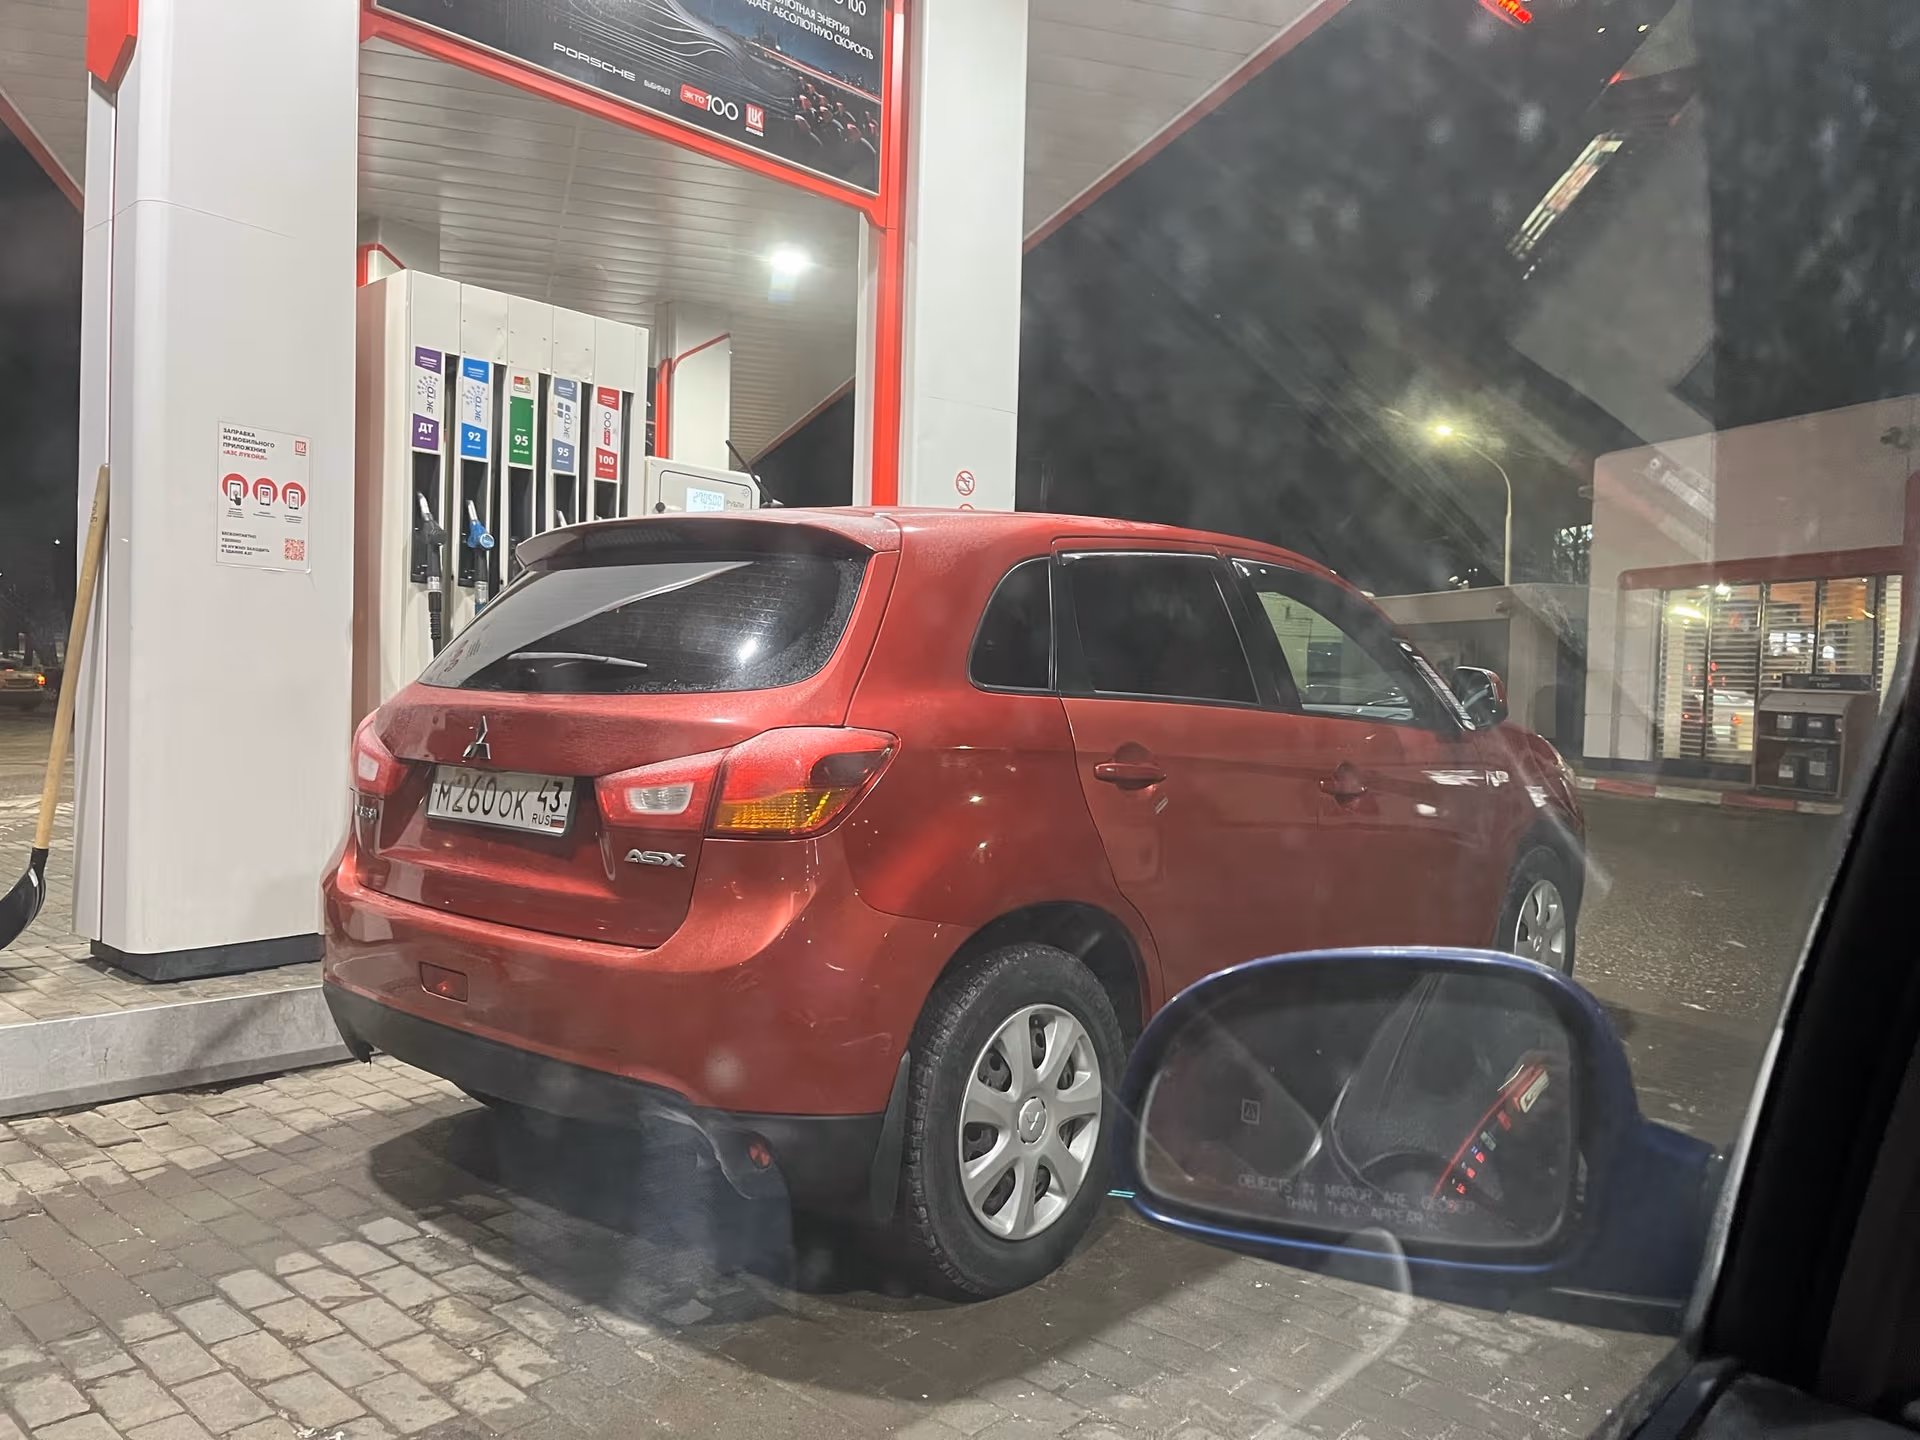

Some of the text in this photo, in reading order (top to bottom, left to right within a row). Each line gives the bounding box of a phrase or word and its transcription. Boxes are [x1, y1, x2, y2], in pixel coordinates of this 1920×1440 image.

[817, 12, 850, 36] ЭНЕРГИЯ
[773, 5, 833, 41] АБСОЛЮТНУЮ
[833, 34, 874, 60] СКОРОСТЬ
[553, 42, 636, 82] PORSCHE
[223, 427, 256, 438] ЗАПРАВКА
[418, 422, 433, 434] ДТ
[232, 436, 275, 448] МОБИЛЬНОГО
[467, 431, 481, 442] 92
[514, 434, 529, 446] 95
[223, 442, 267, 454] ПРИЛОЖЕНИЯ
[557, 447, 569, 457] 95
[598, 454, 615, 465] 100
[436, 772, 564, 821] М260ОК 43
[532, 813, 550, 826] RUS
[623, 848, 687, 868] ASX
[1238, 1176, 1292, 1194] OBJECTS
[1324, 1182, 1372, 1201] MIRROR
[1384, 1191, 1407, 1208] ARE
[1286, 1195, 1318, 1213] THAN
[1327, 1200, 1359, 1217] THEY
